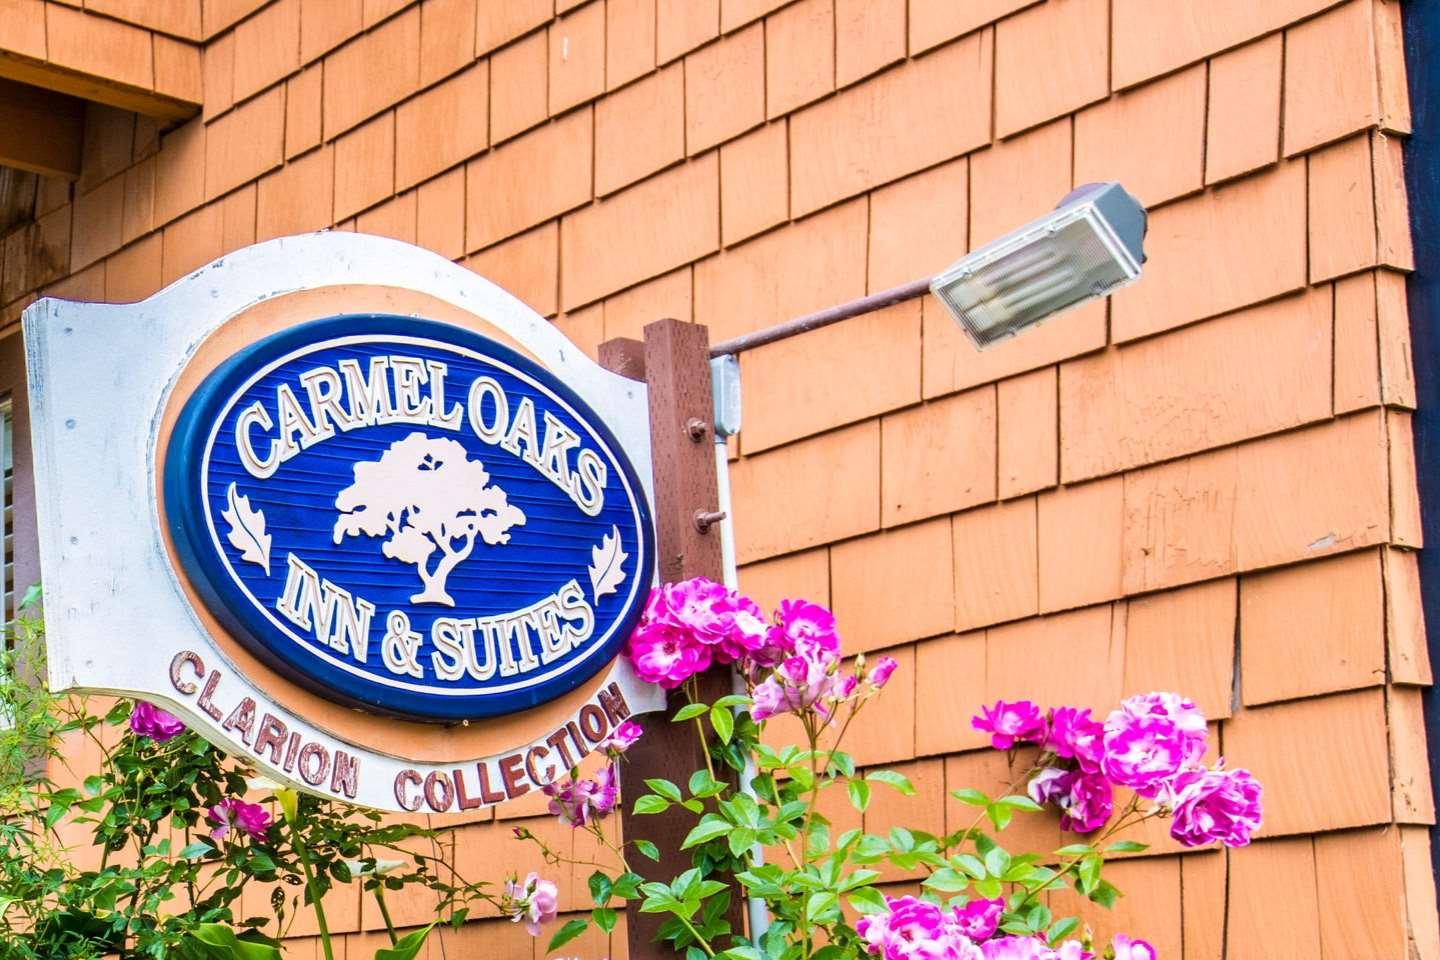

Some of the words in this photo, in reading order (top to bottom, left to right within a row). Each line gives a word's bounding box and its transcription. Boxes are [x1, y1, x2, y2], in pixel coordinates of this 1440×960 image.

[235, 358, 464, 479] CARMEL
[469, 376, 608, 516] OAKS
[277, 553, 375, 662] INN
[382, 610, 423, 678] &
[432, 579, 595, 681] SUITES
[169, 651, 359, 798] CLARION
[394, 681, 632, 812] COLLECTION
